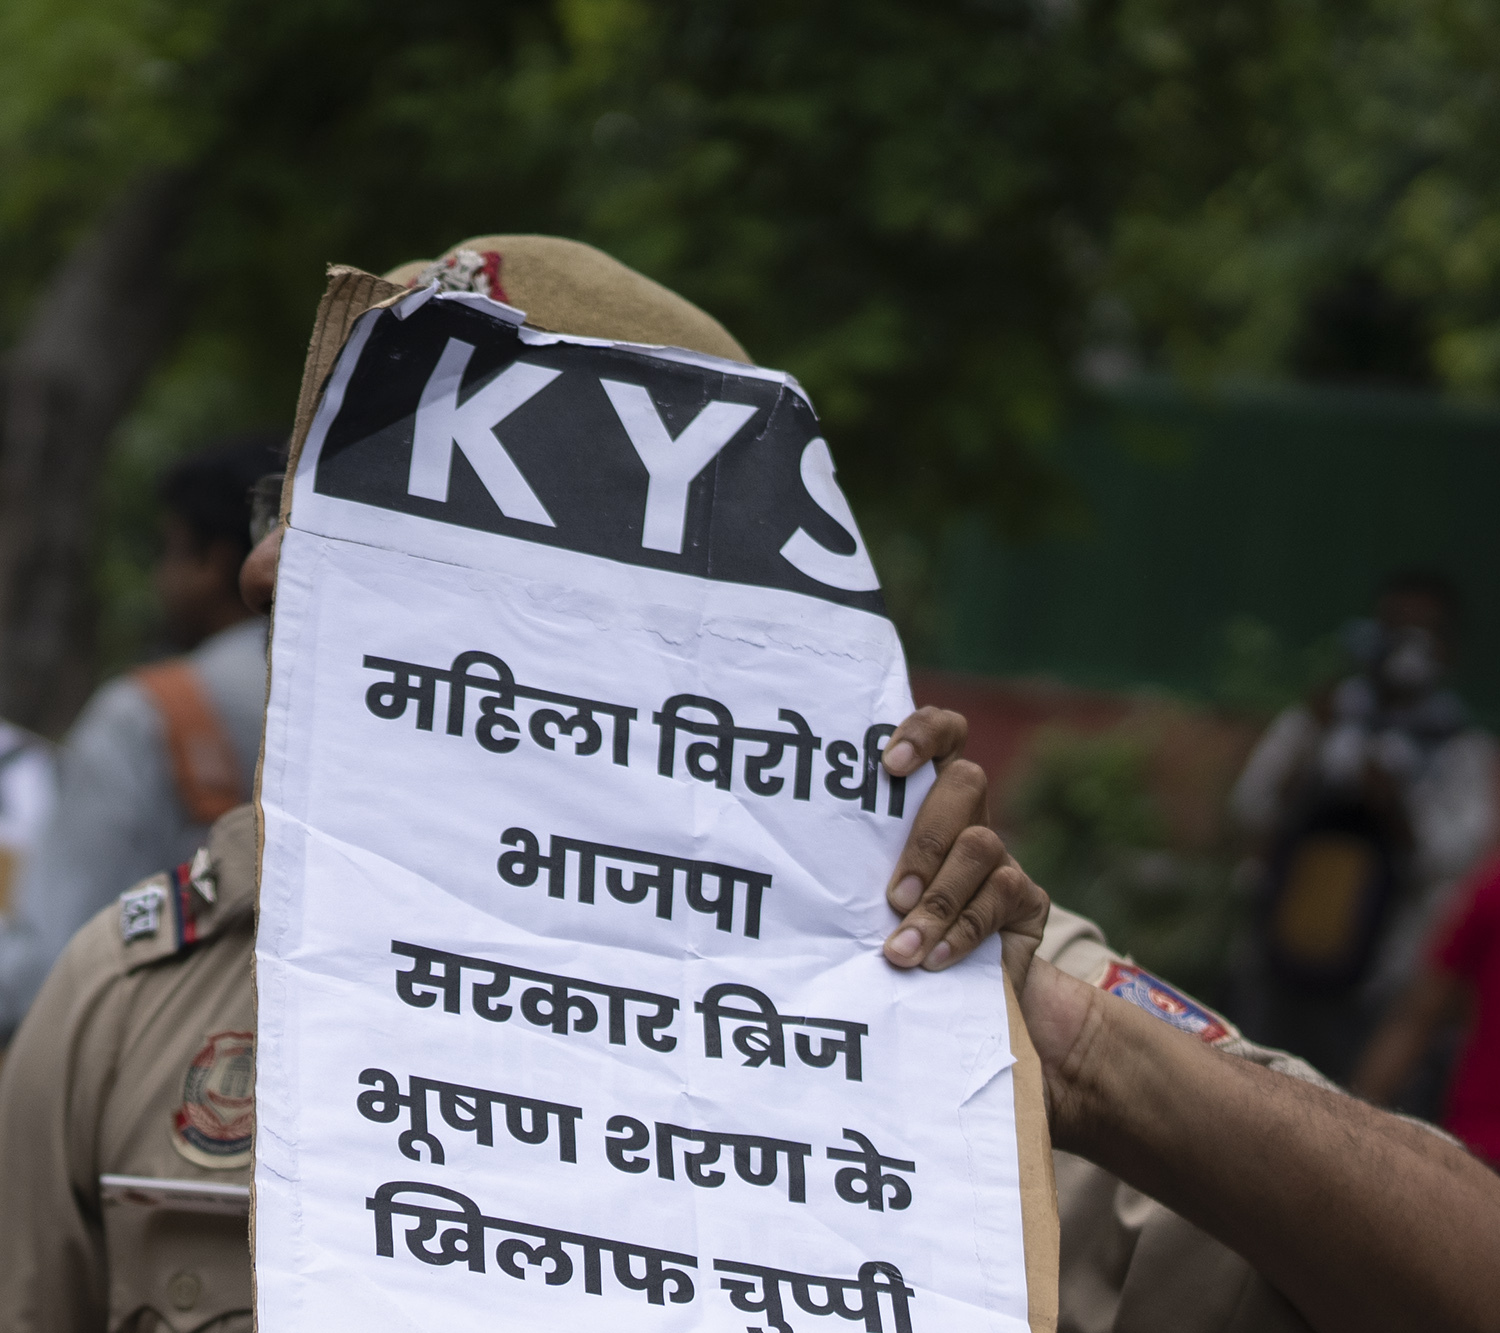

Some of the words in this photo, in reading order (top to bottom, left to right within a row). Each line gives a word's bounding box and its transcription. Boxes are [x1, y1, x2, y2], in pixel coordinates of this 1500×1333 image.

[406, 336, 883, 592] KYS
[362, 650, 638, 767] महिला
[651, 692, 905, 820] विरोधी
[497, 826, 773, 940] भाजपा
[390, 939, 680, 1053] सरकार
[694, 982, 869, 1082] ब्रिज
[357, 1067, 583, 1166] भूषण
[604, 1114, 812, 1204] शरण
[826, 1127, 916, 1213] के
[365, 1181, 699, 1306] खिलाफ
